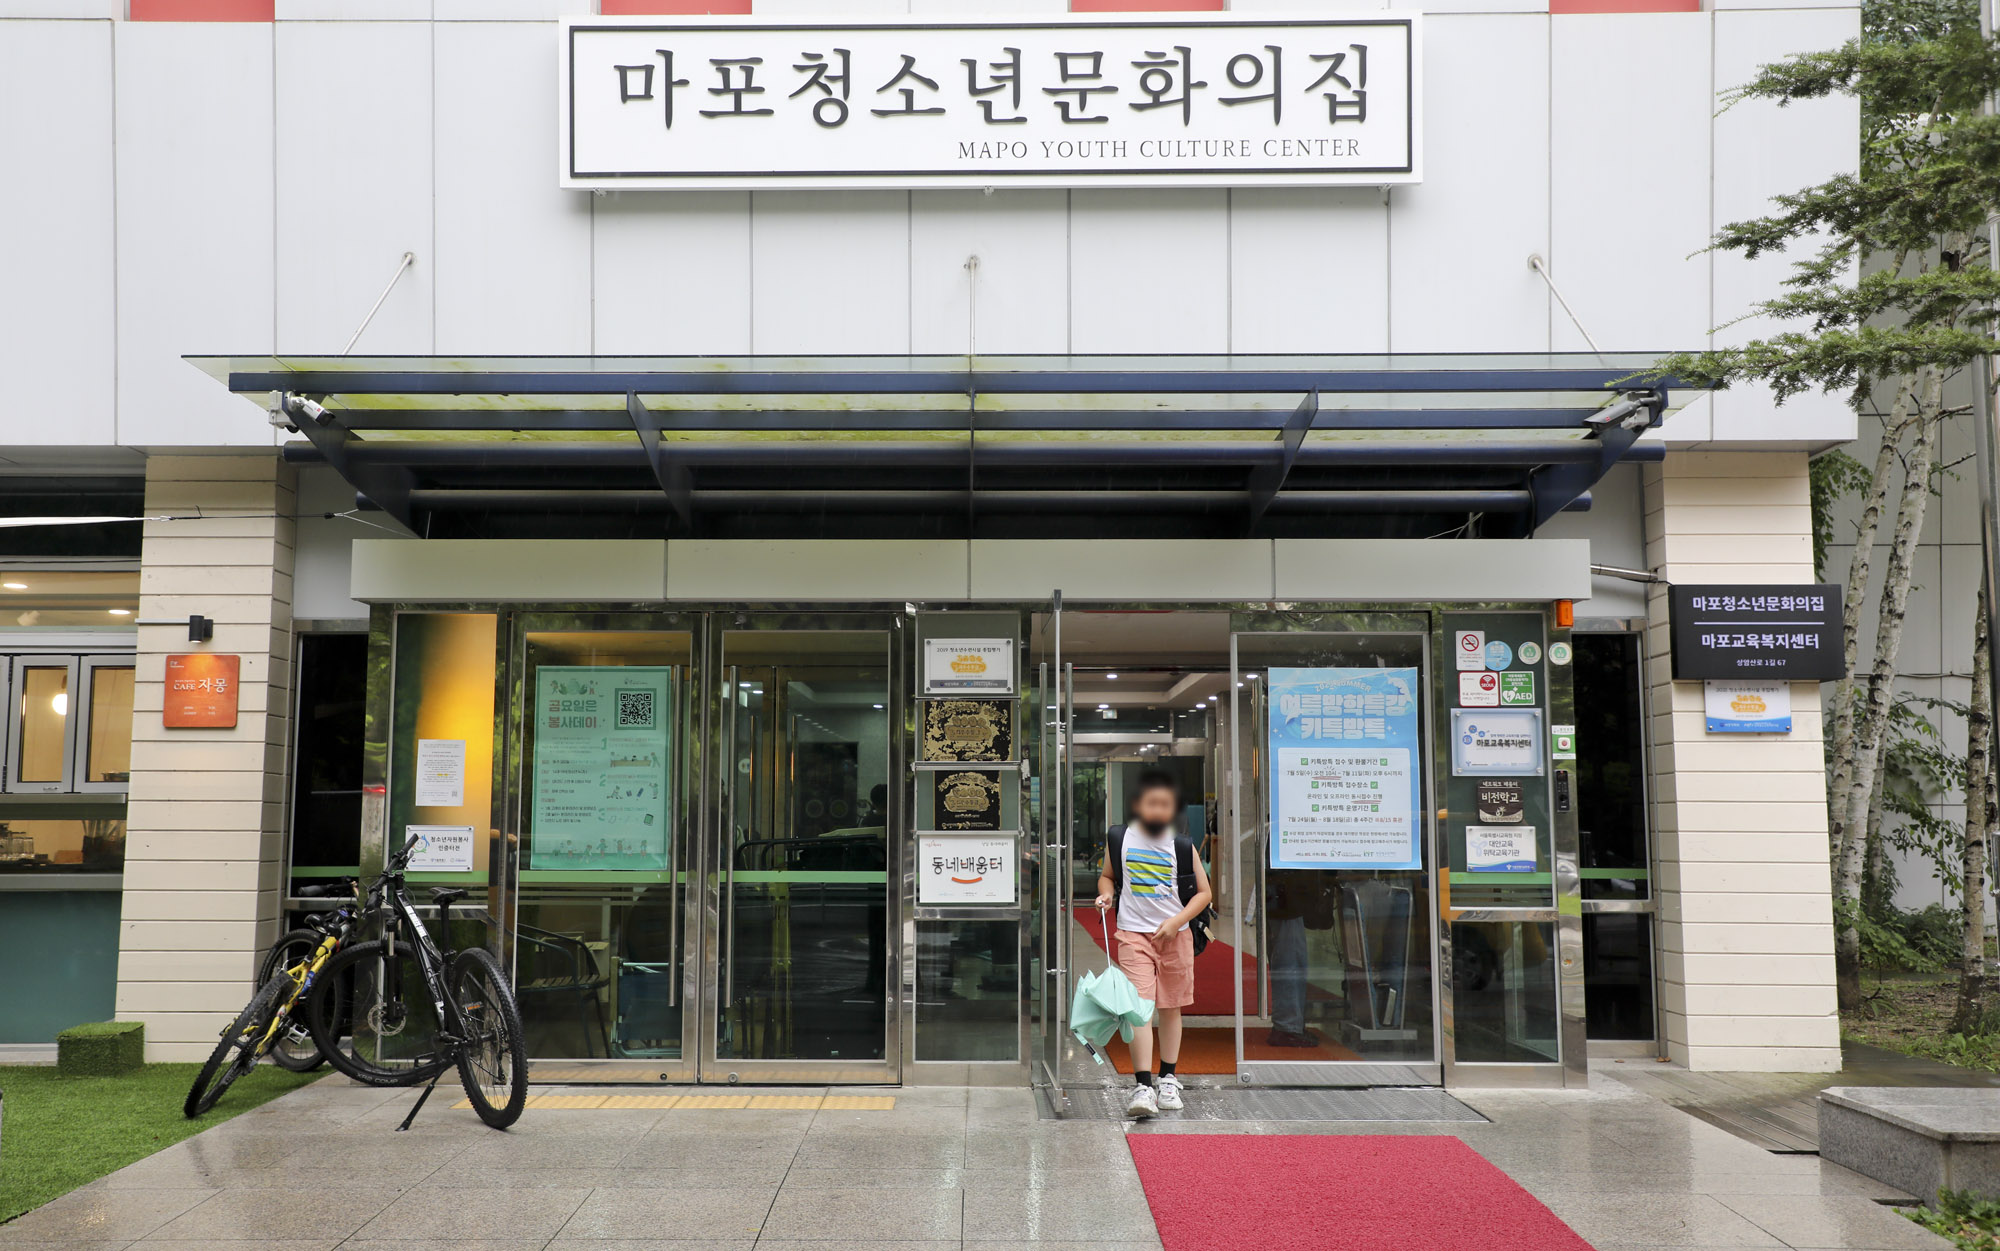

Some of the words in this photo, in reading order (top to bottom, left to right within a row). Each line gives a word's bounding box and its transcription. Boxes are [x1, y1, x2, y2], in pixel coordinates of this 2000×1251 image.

[614, 44, 1368, 129] 마포청소년문화의집
[958, 141, 1027, 159] MAPO
[1041, 140, 1128, 159] YOUTH
[1140, 140, 1251, 158] CULTURE
[1263, 139, 1360, 157] CENTER
[1692, 596, 1825, 612] 마포청소년문화의집
[1701, 633, 1819, 649] 마포교육복지센터
[198, 677, 228, 693] 자몽
[1515, 692, 1532, 700] AED
[1280, 694, 1406, 716] 여름방학특강
[548, 716, 597, 728] 봉사데이
[1476, 739, 1532, 748] 마포교육복지센터
[1481, 791, 1519, 804] 비전학교
[1488, 840, 1514, 848] 대안교육
[932, 856, 1003, 875] 동네배움터
